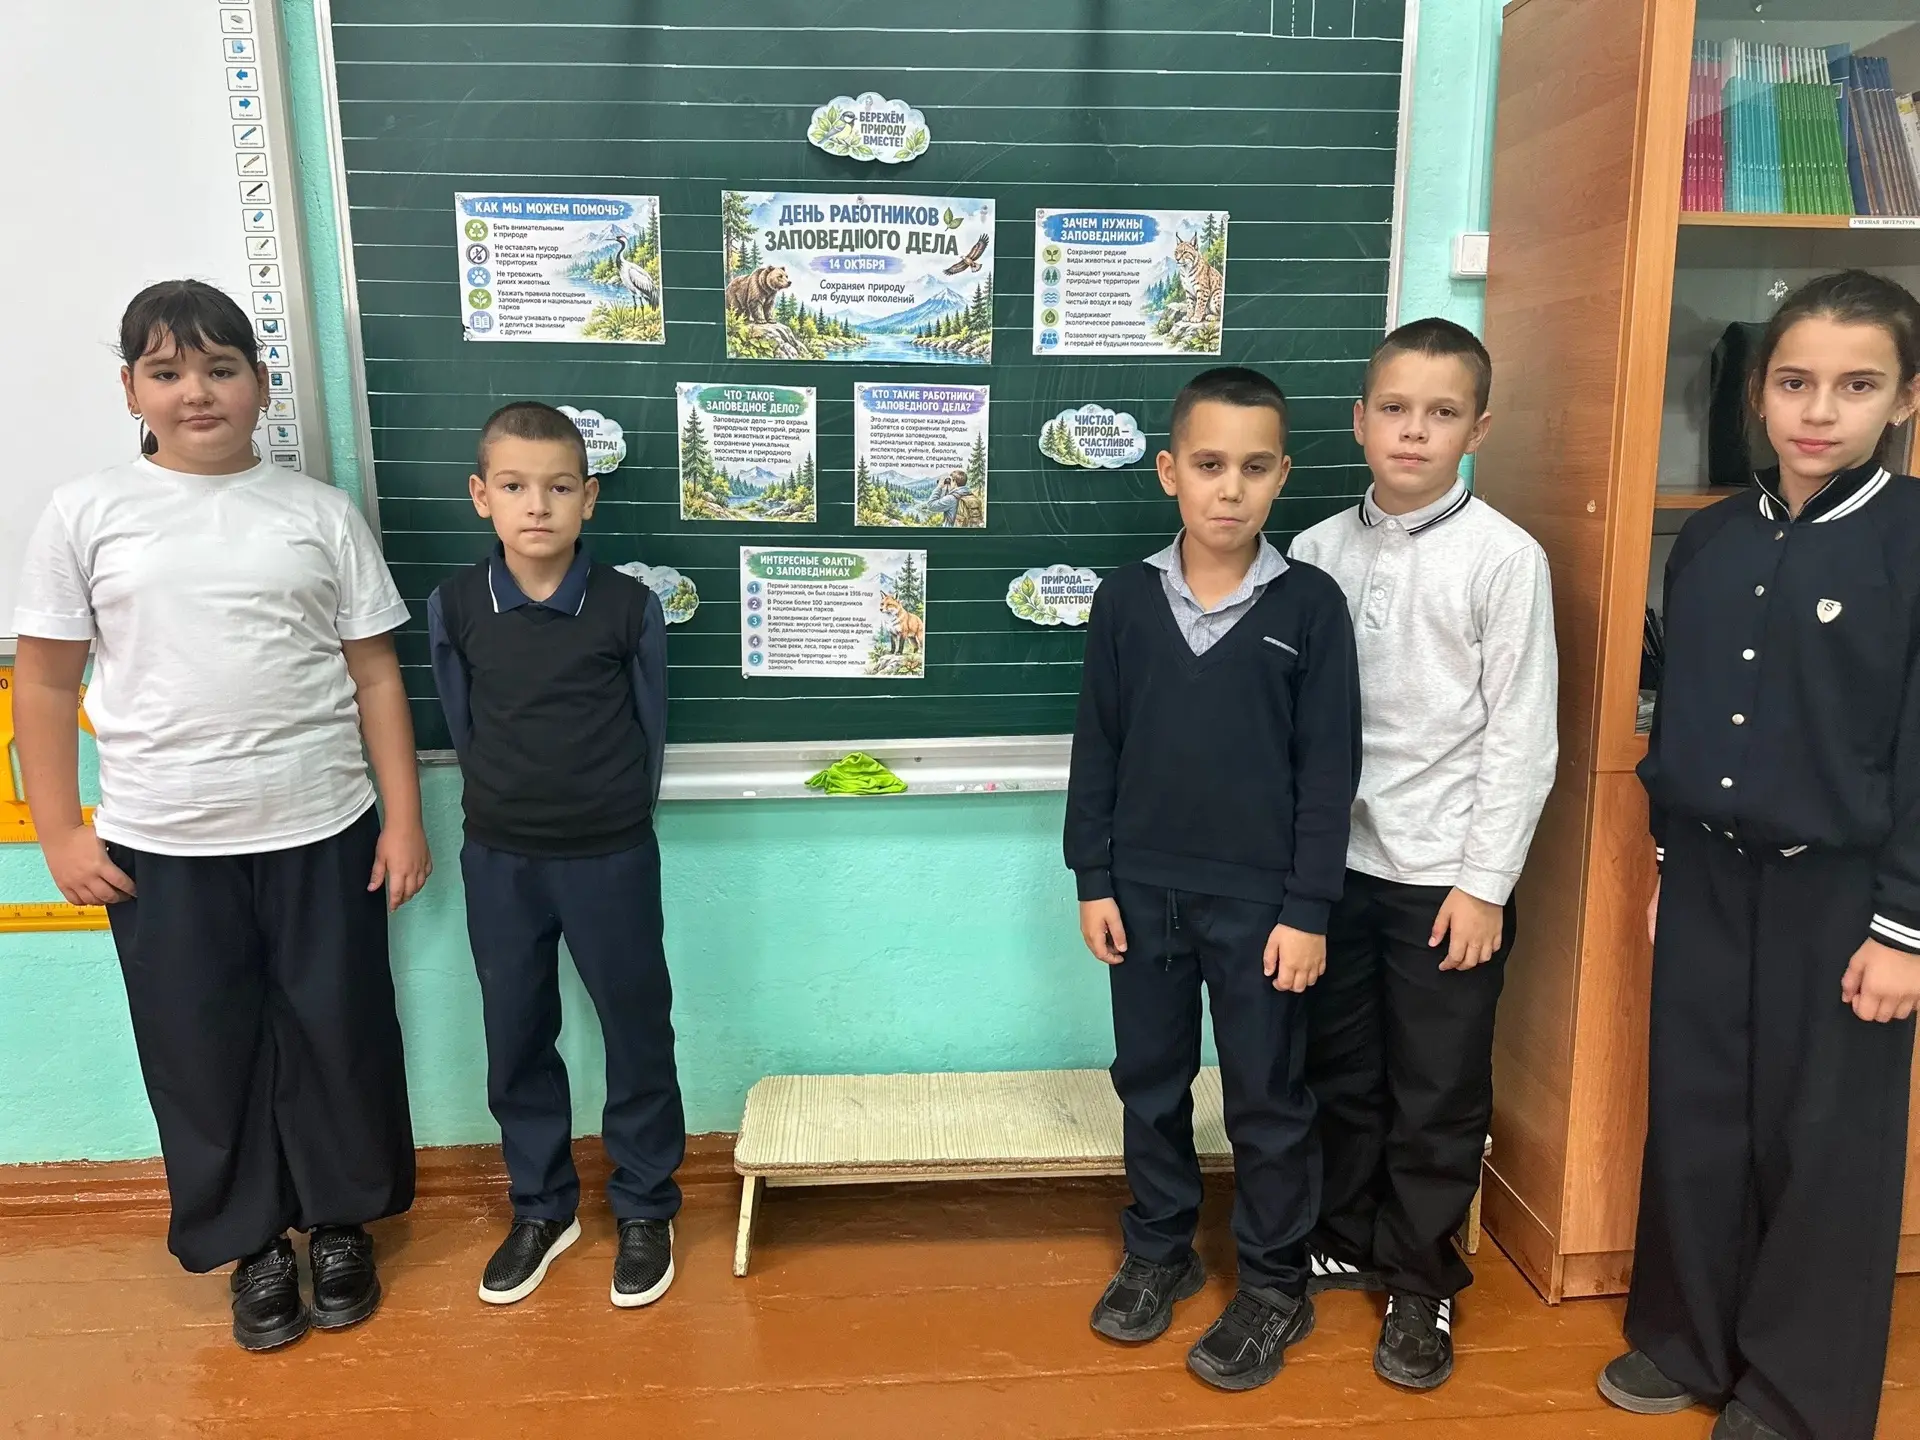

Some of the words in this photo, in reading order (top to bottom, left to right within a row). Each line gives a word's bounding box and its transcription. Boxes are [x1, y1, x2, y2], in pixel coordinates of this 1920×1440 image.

[860, 111, 904, 123] БЕРЕЖЁМ
[861, 124, 906, 136] ПРИРОДУ
[863, 136, 903, 147] ВМЕСТЕ!
[475, 202, 498, 213] КАК
[503, 202, 522, 213] МЫ
[526, 203, 568, 214] МОЖЕМ
[573, 204, 624, 216] ПОМОЧЬ?
[779, 205, 824, 226] ДЕНЬ
[830, 205, 939, 226] РАБОТНИКОВ
[1063, 218, 1097, 228] ЗАЧЕМ
[1102, 219, 1143, 229] НУЖНЫ
[1061, 231, 1144, 242] ЗАПОВЕДНИКИ?
[906, 231, 958, 256] ДЕЛА
[830, 259, 840, 269] 14
[844, 258, 885, 270] ОКЯБРЯ
[868, 283, 905, 294] природу
[811, 294, 827, 303] для
[868, 294, 914, 304] поколений
[724, 390, 742, 400] ЧТО
[746, 391, 774, 401] ТАКОЕ
[872, 390, 889, 399] КТО
[892, 390, 920, 400] ТАКИЕ
[923, 391, 975, 401] РАБОТНИКИ
[706, 401, 766, 413] ЗАПОВЕДНОЕ
[770, 403, 800, 414] ДЕЛО?
[876, 401, 939, 412] ЗАПОВЕДНОГО
[942, 403, 971, 412] ДЕЛА?
[574, 418, 599, 428] НЯЕМ
[1075, 415, 1114, 425] ЧИСТАЯ
[1075, 427, 1120, 437] ПРИРОДА
[585, 440, 617, 450] АВТРА!
[1079, 438, 1134, 447] СЧАСТЛИВОЕ
[1085, 448, 1125, 457] БУДУЩЕЕ!
[760, 556, 819, 565] ИНТЕРЕСНЫЕ
[822, 557, 856, 566] ФАКТЫ
[766, 566, 774, 575] О
[776, 567, 850, 577] ЗАПОВЕДНИКАХ
[1042, 576, 1082, 584] ПРИРОДА
[1041, 586, 1065, 594] НАШЕ
[1067, 586, 1094, 595] ОБЩЕЕ
[1044, 596, 1092, 604] БОГАТСТВО!
[1824, 602, 1834, 612] S
